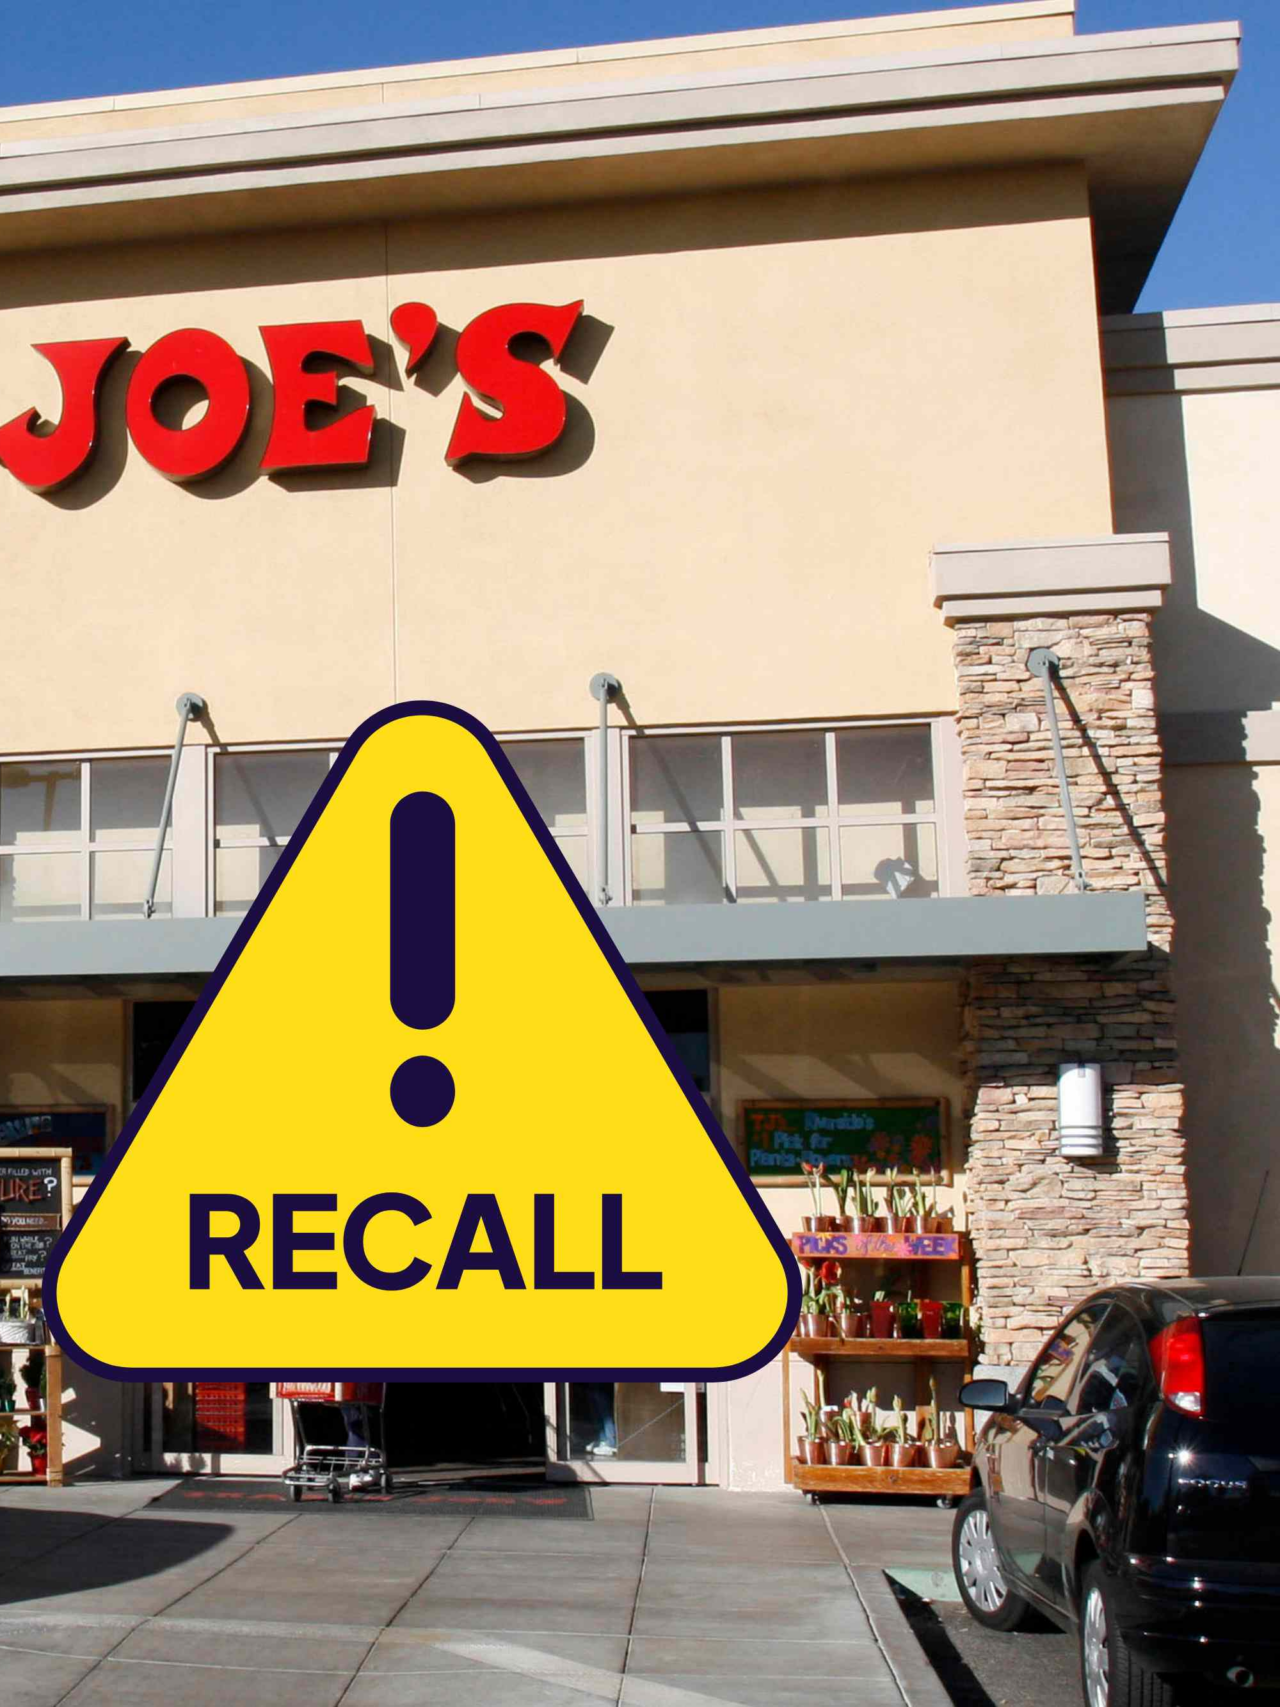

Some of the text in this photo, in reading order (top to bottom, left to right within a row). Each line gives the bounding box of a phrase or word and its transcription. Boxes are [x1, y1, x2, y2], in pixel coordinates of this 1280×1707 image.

[809, 1132, 834, 1150] for
[8, 1167, 30, 1176] FILLED
[31, 1167, 52, 1176] WITH
[11, 1216, 26, 1225] YOU
